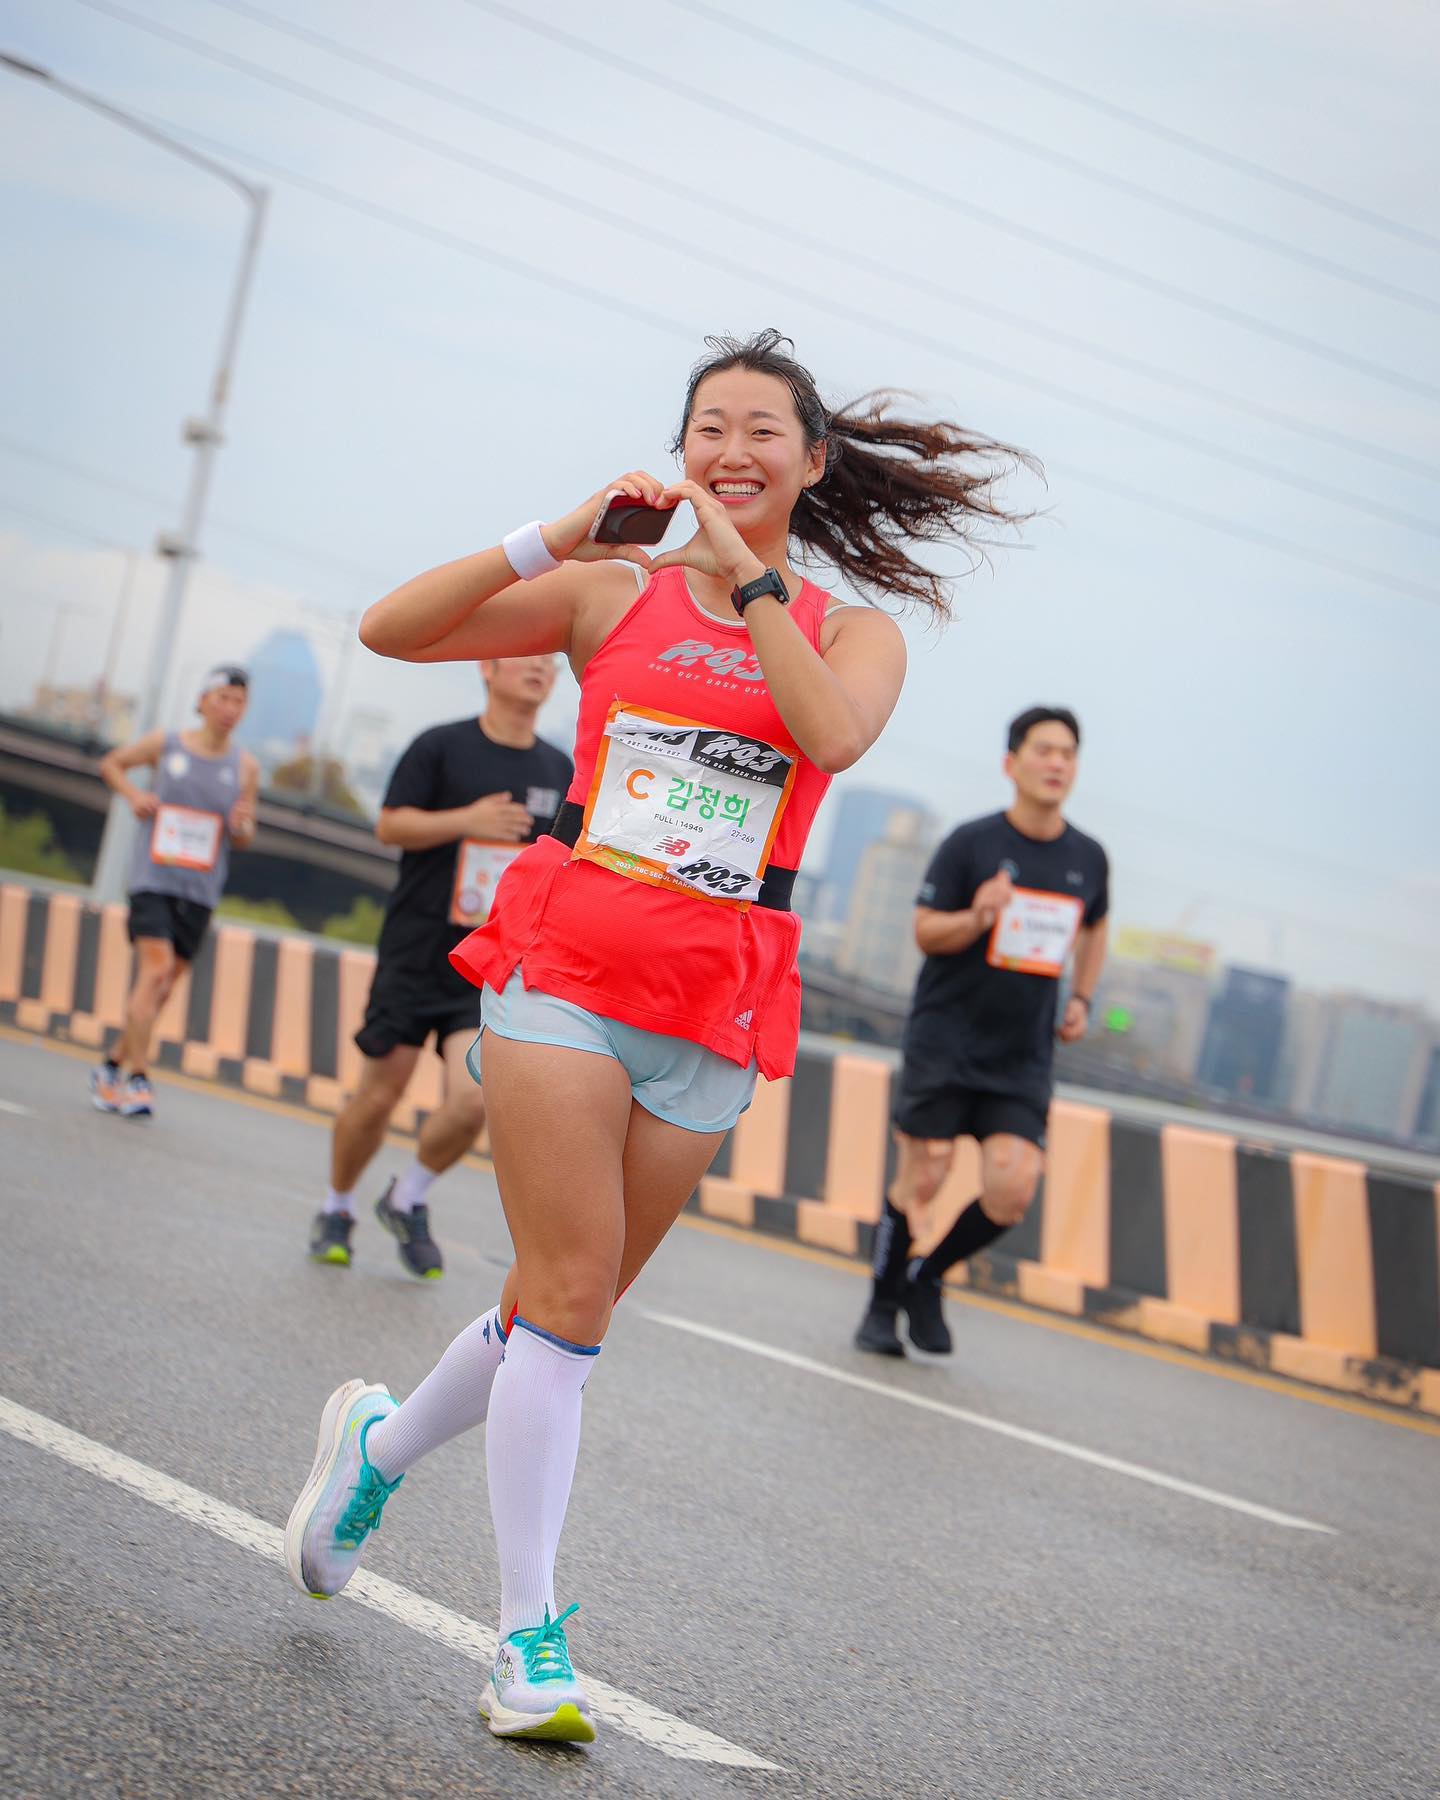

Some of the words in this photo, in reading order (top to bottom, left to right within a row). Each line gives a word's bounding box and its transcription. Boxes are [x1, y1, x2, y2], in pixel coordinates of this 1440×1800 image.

[647, 663, 671, 673] RUN
[677, 671, 701, 681] OUT
[706, 678, 738, 690] DASH
[744, 687, 767, 696] OUT
[713, 762, 728, 770] OUT
[752, 775, 767, 783] OUT
[626, 768, 656, 800] C
[666, 776, 751, 829] 김정희
[654, 813, 673, 825] FULL
[680, 821, 704, 833] 14949
[730, 829, 755, 844] 27-269
[632, 865, 649, 875] JTBC
[649, 870, 671, 882] SEOUL
